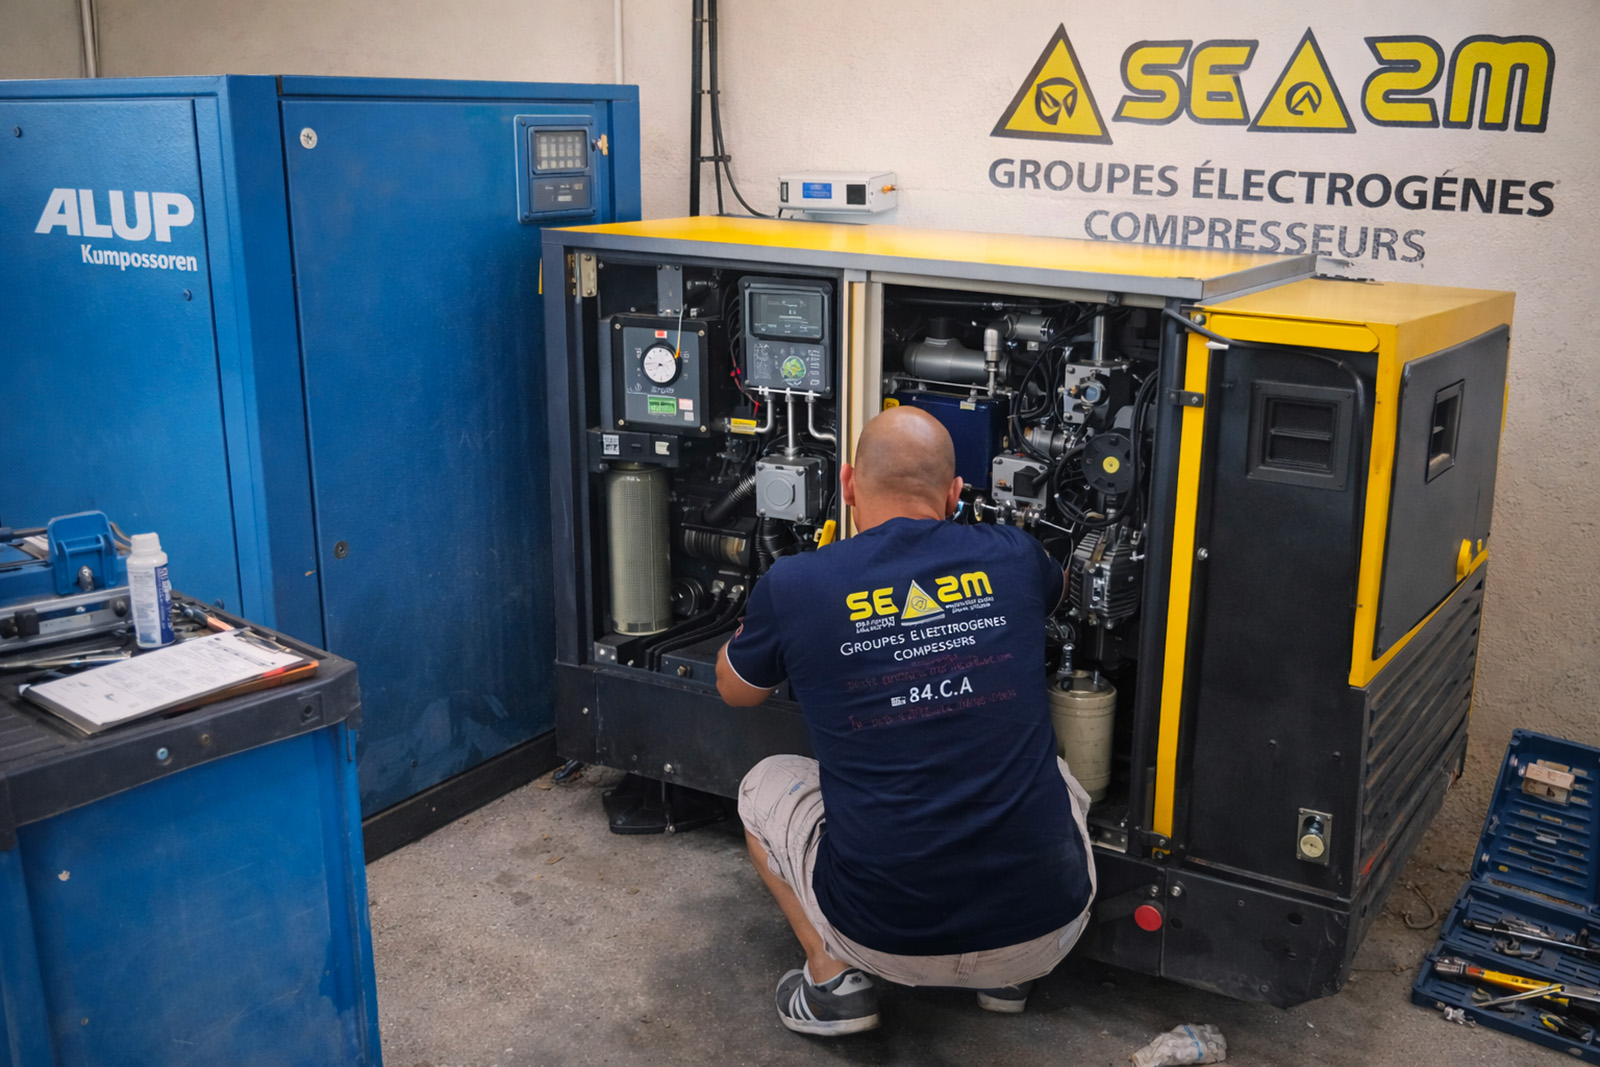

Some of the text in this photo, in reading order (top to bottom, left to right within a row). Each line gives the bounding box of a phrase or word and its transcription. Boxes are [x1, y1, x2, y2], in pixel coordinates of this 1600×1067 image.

[988, 158, 1179, 197] GROUPES
[34, 188, 195, 242] ALUP
[1084, 209, 1426, 263] COMPRESSEURS
[80, 244, 198, 271] Kumpossoren
[840, 634, 905, 656] GROUPES
